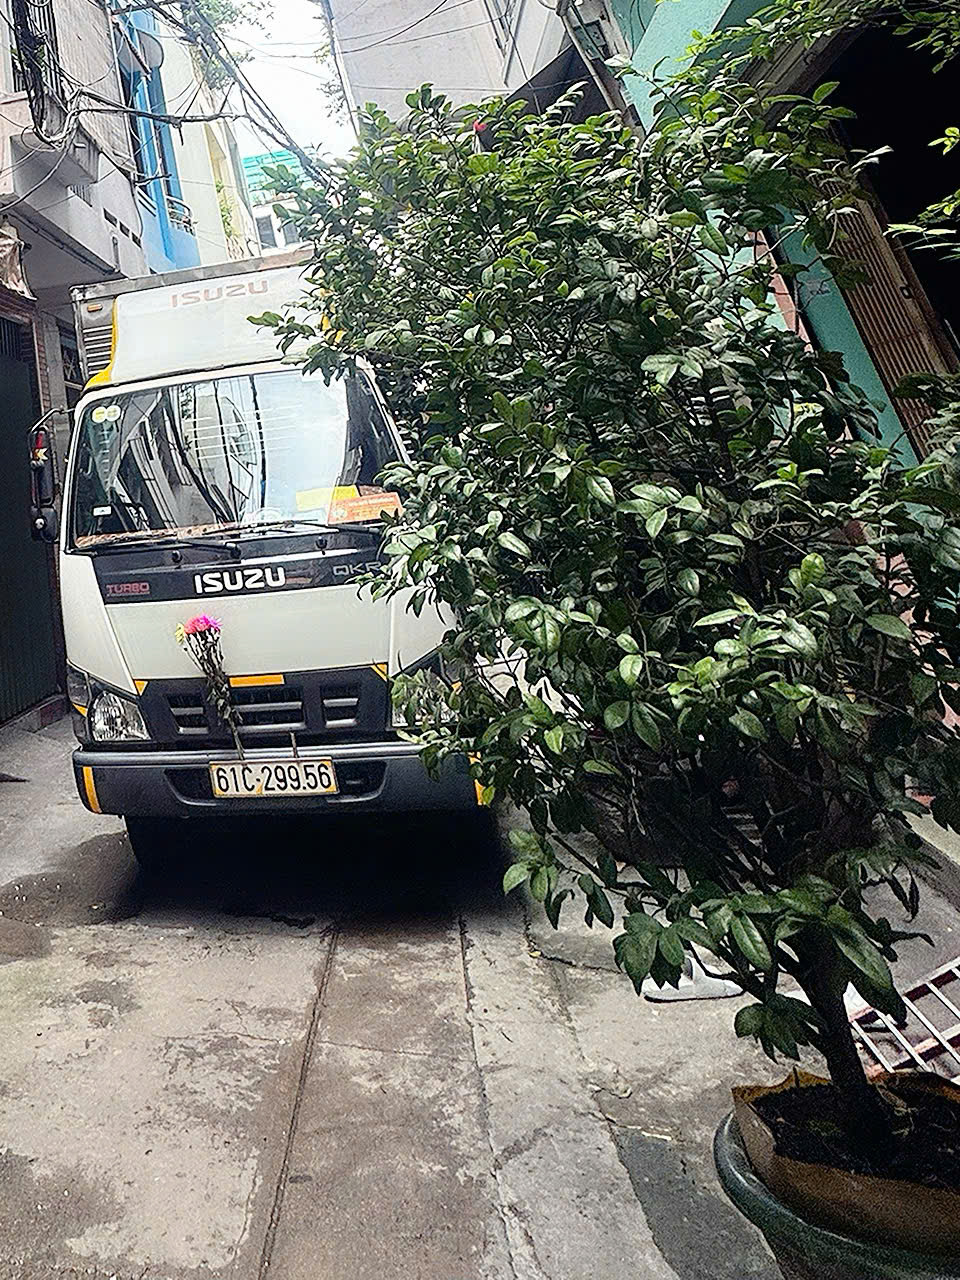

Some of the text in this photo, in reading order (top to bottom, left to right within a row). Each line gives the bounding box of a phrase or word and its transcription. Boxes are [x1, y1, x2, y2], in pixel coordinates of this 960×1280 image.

[172, 280, 268, 307] ISUZU
[106, 582, 150, 593] TURBO
[194, 567, 287, 594] ISUZU
